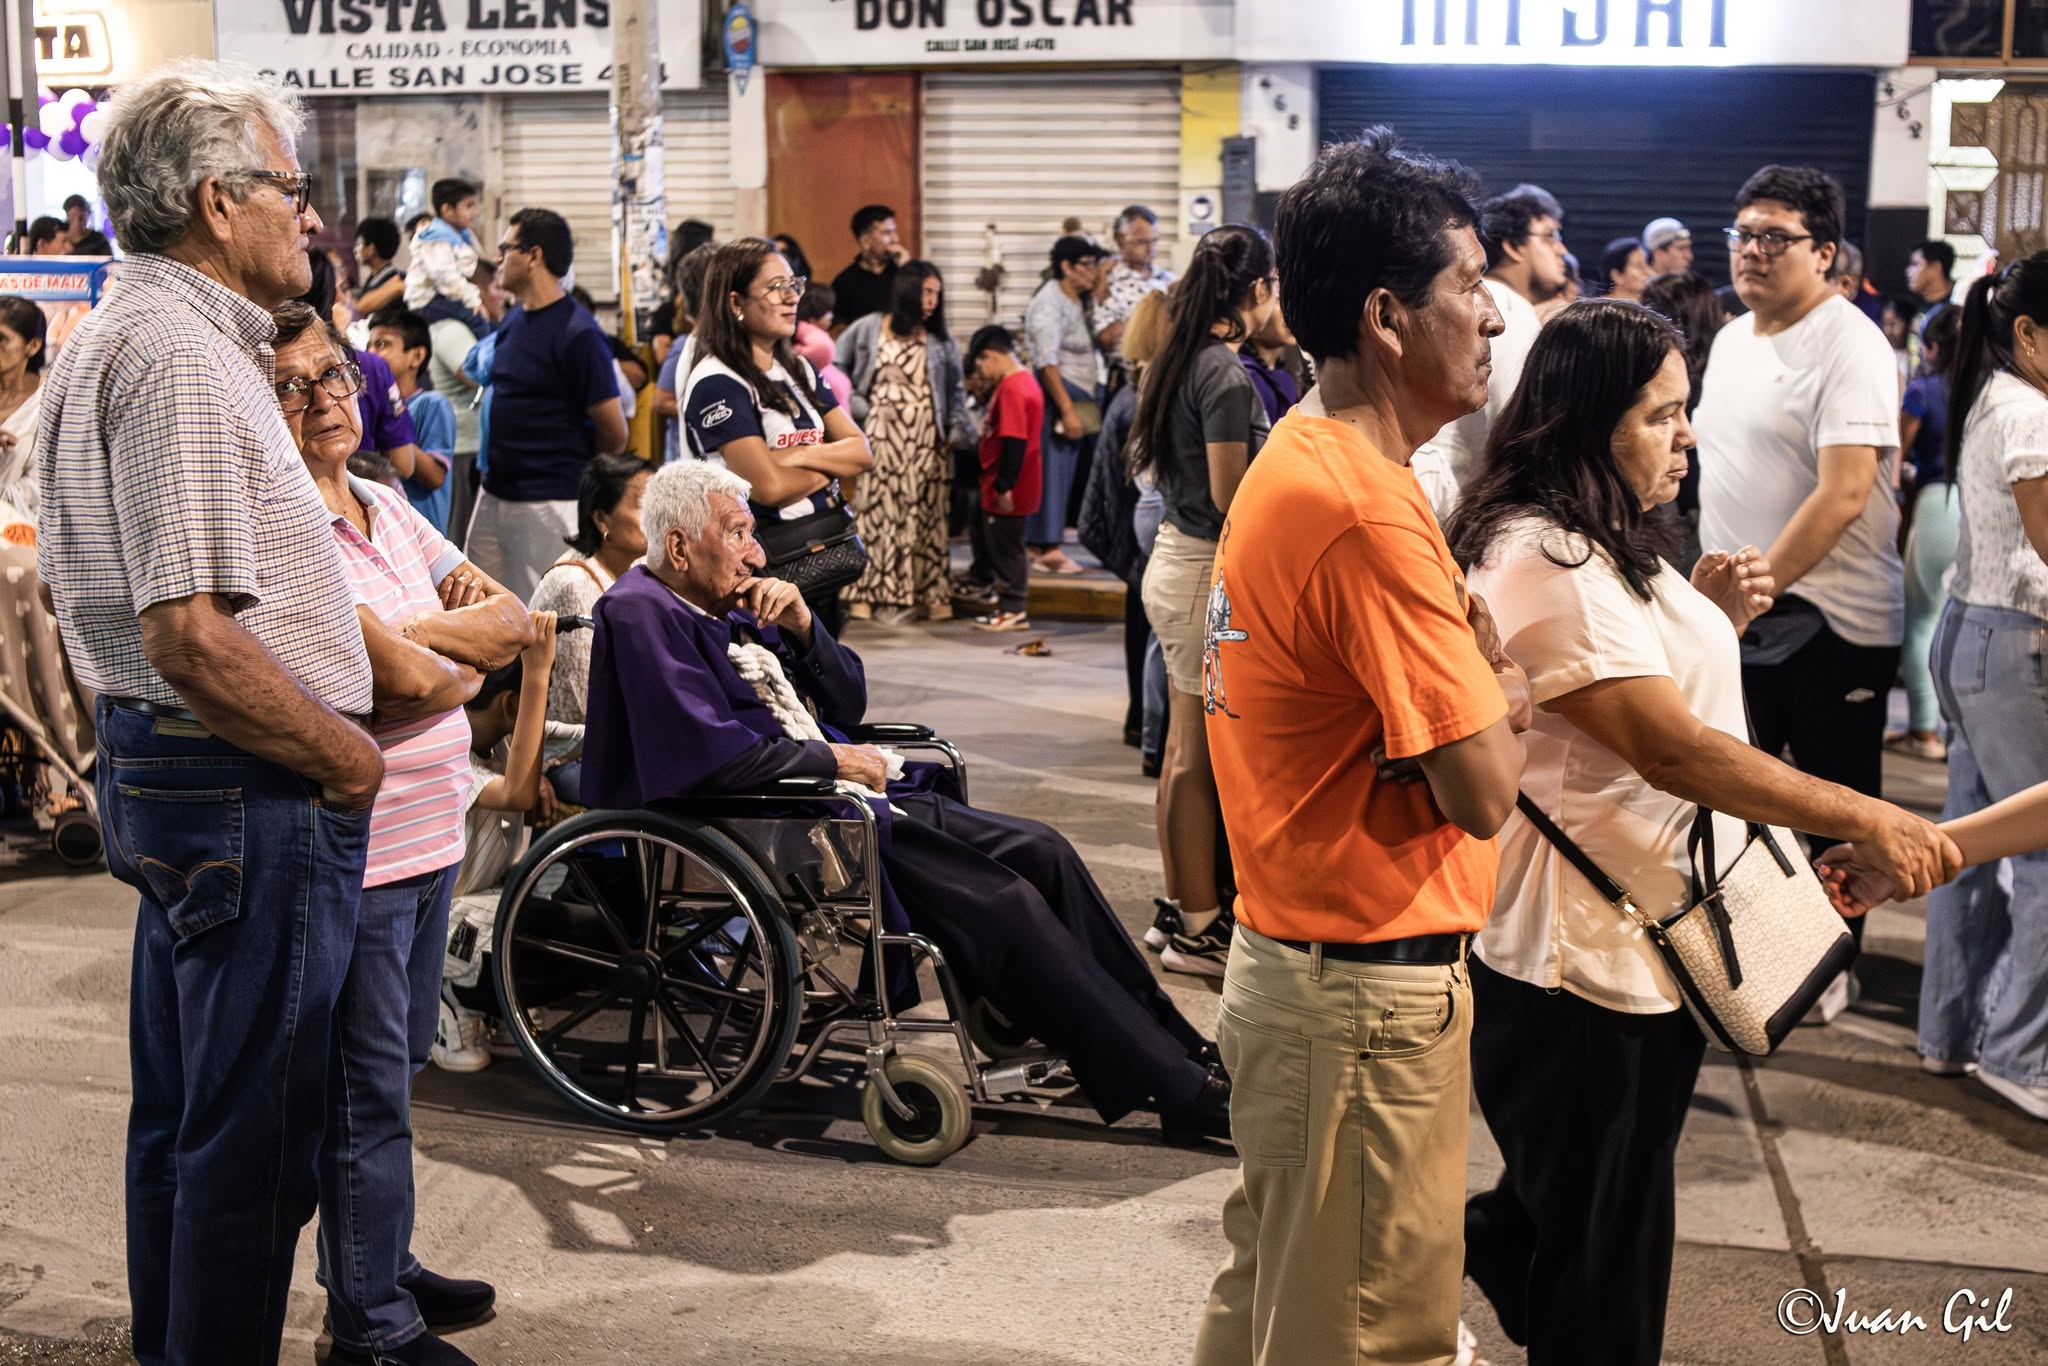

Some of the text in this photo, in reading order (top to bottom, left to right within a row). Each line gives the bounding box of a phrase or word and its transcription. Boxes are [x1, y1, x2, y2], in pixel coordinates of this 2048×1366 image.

[281, 0, 609, 35] VISTA LENS
[856, 0, 1134, 30] DON OSCAR
[346, 42, 440, 60] CALIDAD
[461, 39, 572, 57] ECONOMIA
[258, 67, 375, 89] ALLE
[389, 66, 465, 88] SAN
[480, 63, 583, 85] JOSE
[23, 275, 43, 290] DE
